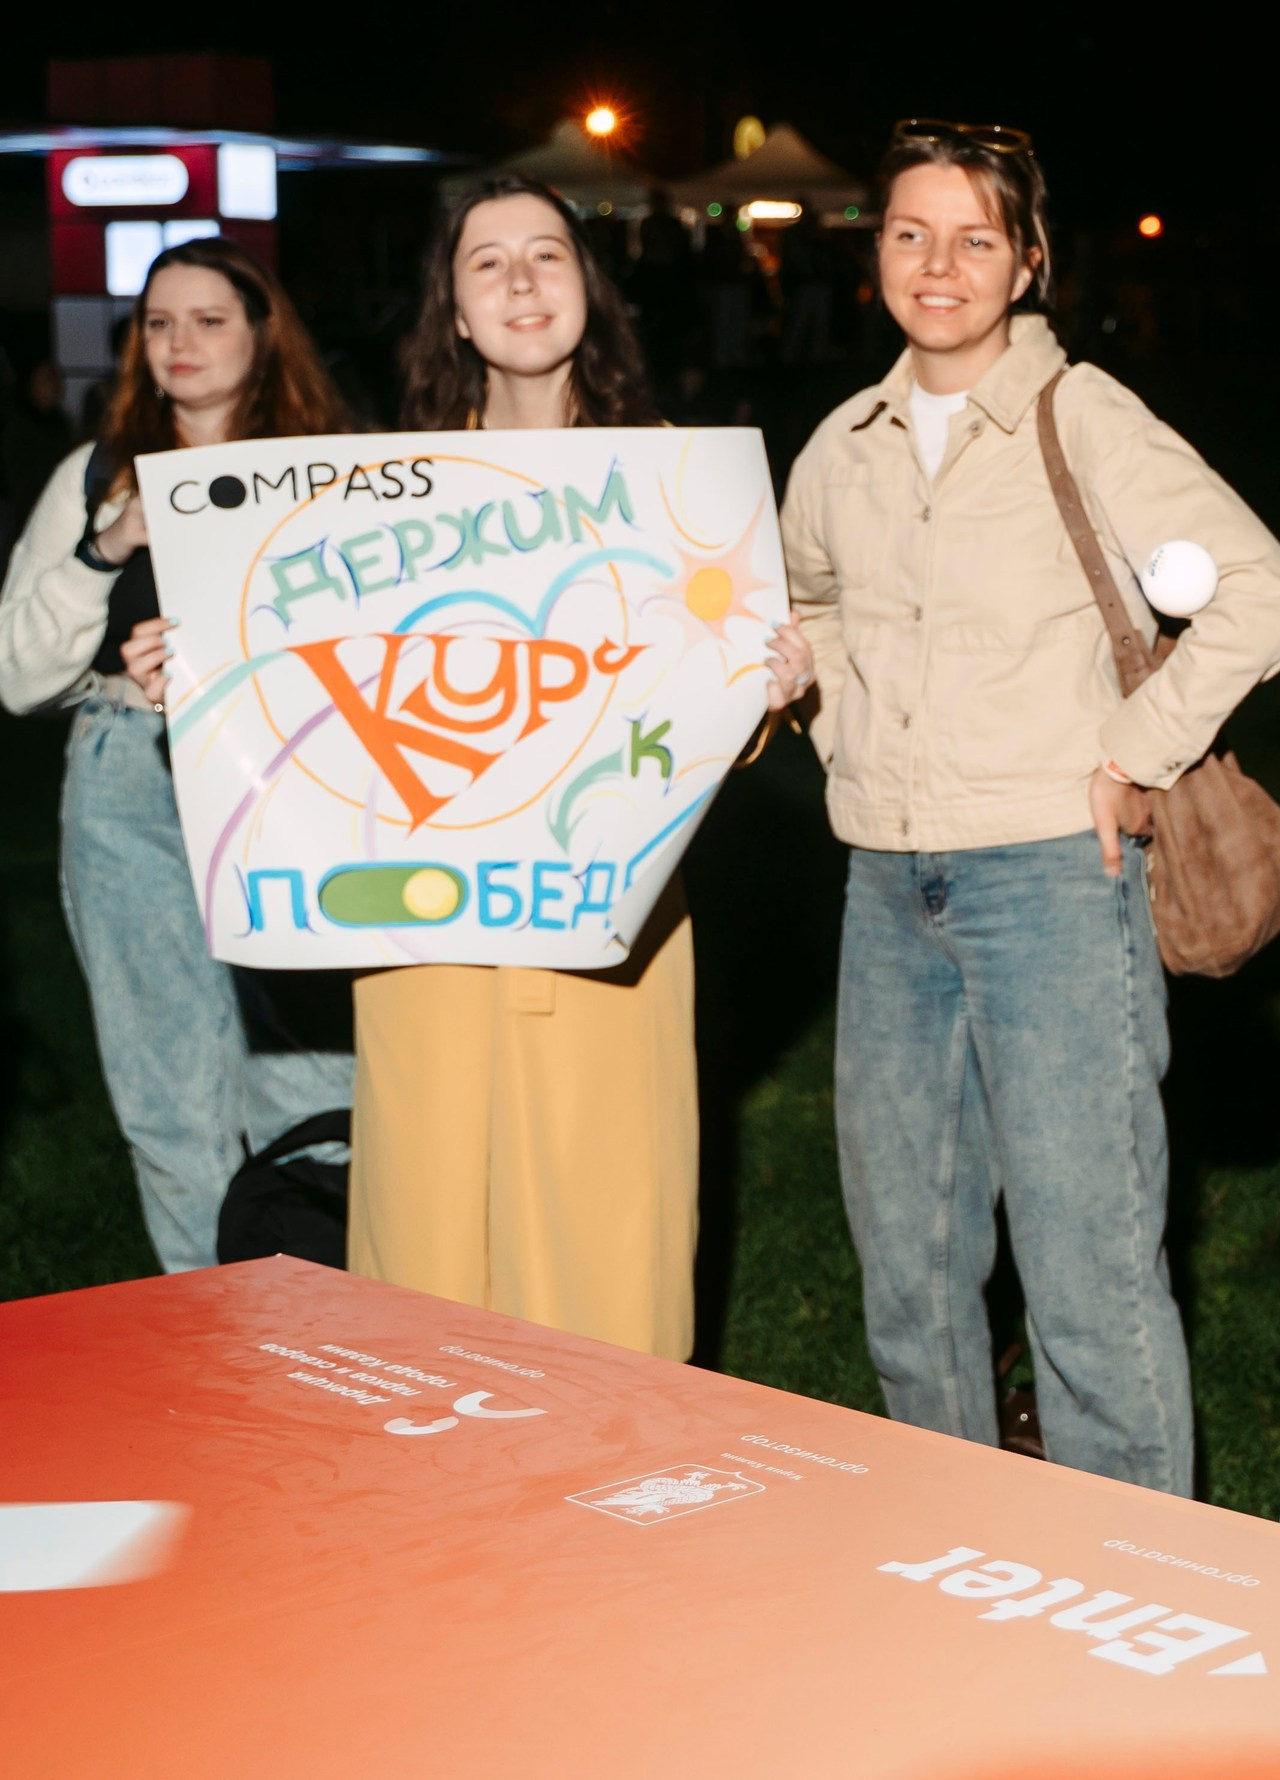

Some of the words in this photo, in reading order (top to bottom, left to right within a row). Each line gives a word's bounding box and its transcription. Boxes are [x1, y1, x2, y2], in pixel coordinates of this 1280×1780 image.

[169, 456, 435, 516] COMPASS
[262, 465, 638, 628] ДЕРЖИМ
[259, 1343, 336, 1369] скверов
[318, 1344, 388, 1368] Казани
[333, 1366, 350, 1375] и
[439, 1345, 546, 1378] организатор
[286, 1371, 391, 1405] Дирекция
[349, 1372, 422, 1396] парков
[384, 1364, 457, 1388] города
[741, 1434, 869, 1474] организатор
[1103, 1538, 1261, 1588] организатор
[875, 1546, 1253, 1675] Enter
